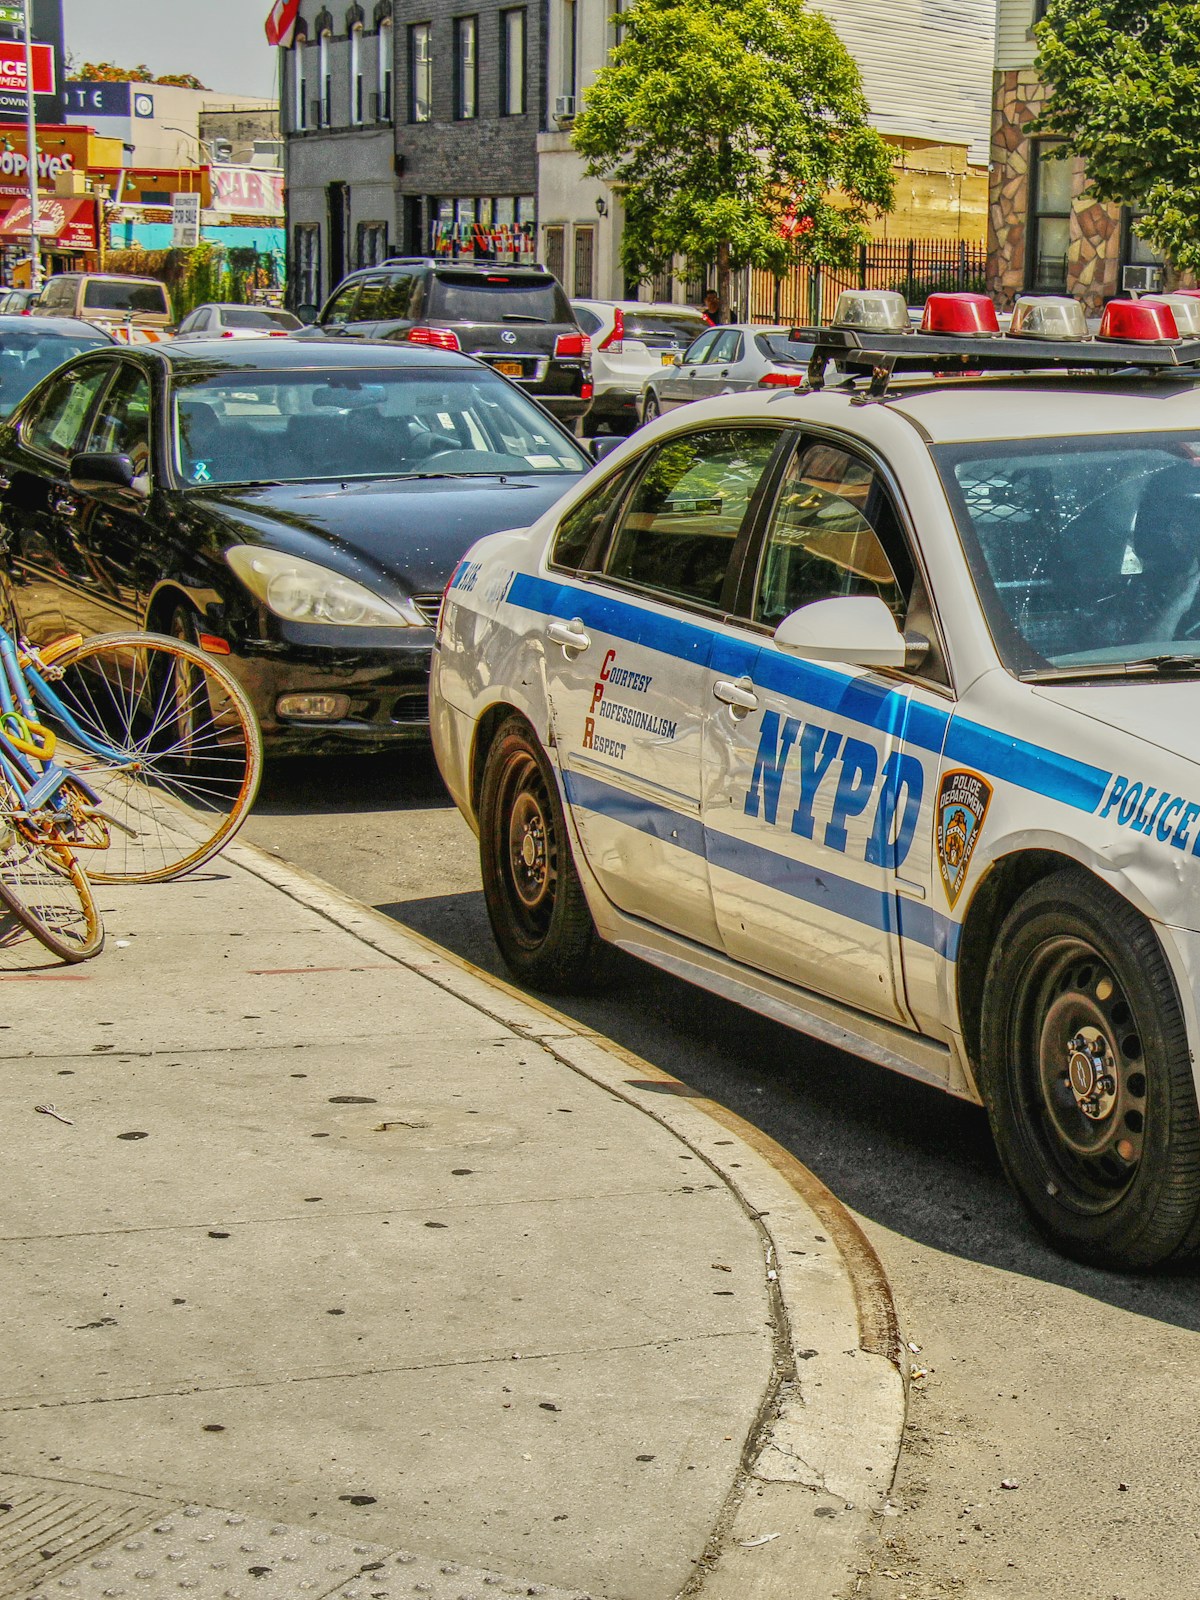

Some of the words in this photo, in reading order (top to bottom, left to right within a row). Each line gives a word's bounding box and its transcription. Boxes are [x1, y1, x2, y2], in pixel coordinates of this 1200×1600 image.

[174, 209, 184, 223] FOR
[185, 209, 197, 224] SALE
[600, 649, 652, 693] COURTESY
[589, 682, 678, 739] PROFESSIONALISM
[582, 716, 627, 760] RESPECT
[744, 709, 924, 869] NYPD
[940, 790, 985, 821] DEPARTMENT
[952, 776, 982, 797] POLICE
[937, 826, 945, 857] CITY
[941, 865, 949, 880] OF
[954, 867, 965, 893] NEW
[964, 829, 978, 862] YORK
